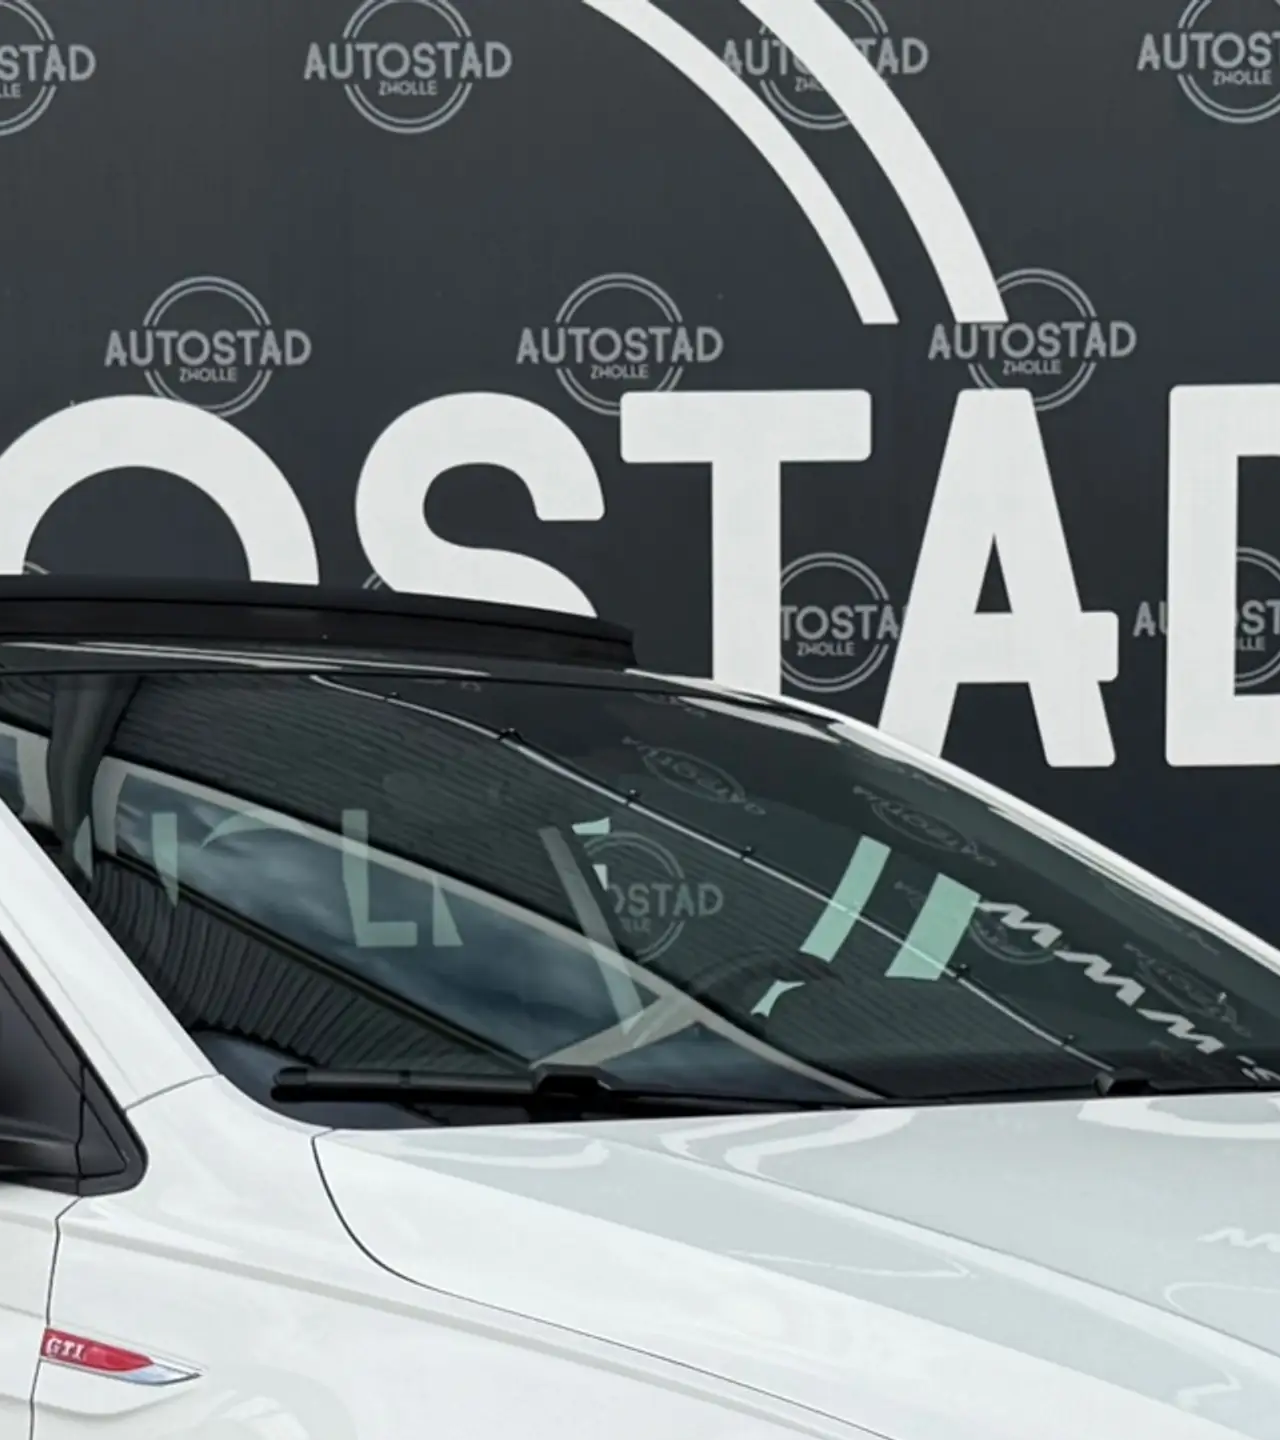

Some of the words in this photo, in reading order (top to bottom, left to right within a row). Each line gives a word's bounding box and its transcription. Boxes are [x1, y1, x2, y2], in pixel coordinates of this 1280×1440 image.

[303, 41, 512, 80] AUTOSTAD
[722, 37, 929, 76] AUTTAD
[378, 80, 437, 96] ZWOLLE
[1212, 70, 1272, 86] ZWOLLE
[104, 328, 312, 366] AUTOSTAD
[516, 325, 723, 363] AUTOSTAD
[928, 321, 1137, 359] AUTOSTAD
[179, 366, 237, 383] ZWOLLE
[590, 363, 649, 380] ZWOLLE
[1002, 359, 1061, 375] ZWOLLE
[781, 604, 907, 640] TOSTA
[796, 641, 856, 656] ZWOLLE
[608, 883, 724, 917] STAD
[45, 1337, 85, 1360] GTI
